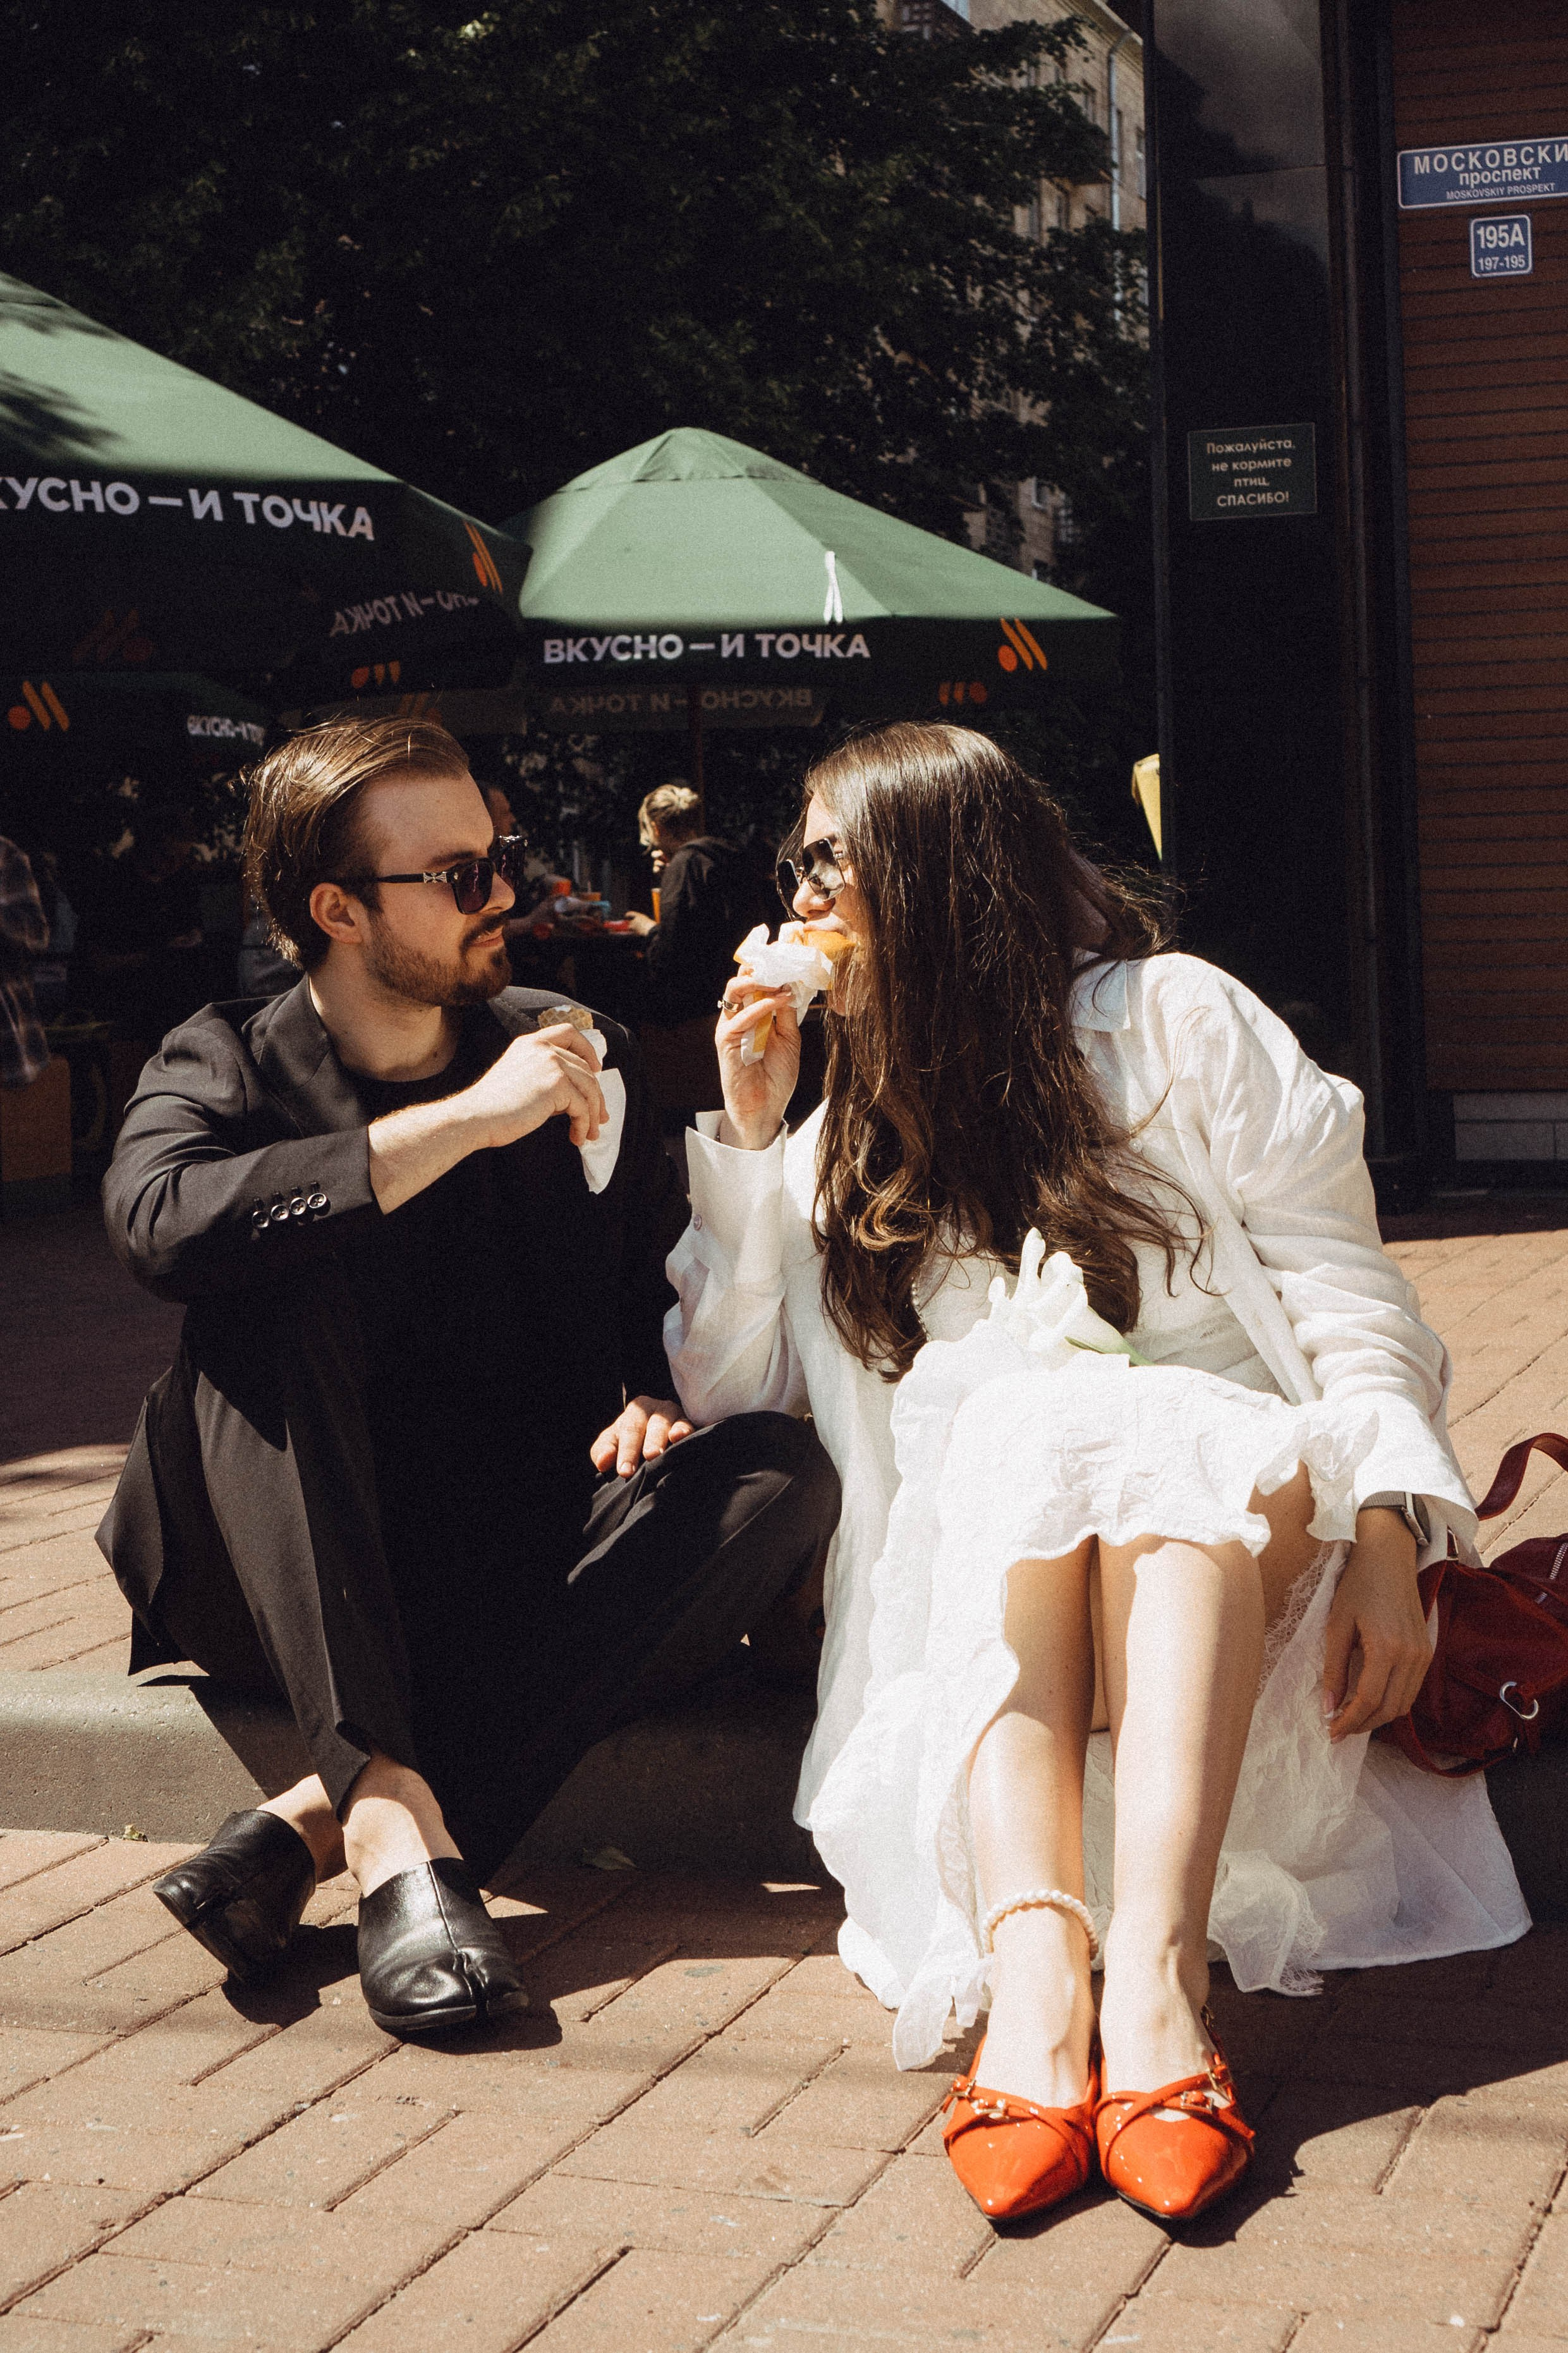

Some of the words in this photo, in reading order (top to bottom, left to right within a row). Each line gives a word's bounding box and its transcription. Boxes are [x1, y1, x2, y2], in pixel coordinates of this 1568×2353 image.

[1459, 167, 1541, 189] проспект
[1446, 186, 1505, 200] MOSKOVSKIY
[1507, 182, 1556, 195] PROSPEKT
[1476, 223, 1526, 249] 195А
[1478, 255, 1526, 271] 197-195
[1212, 461, 1229, 472] не
[1232, 458, 1292, 472] кормите
[1217, 491, 1290, 506] СПАСИБО!
[0, 477, 140, 516] УСНО
[188, 488, 224, 522] И
[231, 491, 375, 541] ТОЧКА
[543, 633, 684, 664] ВКУСНО
[720, 634, 744, 658] И
[755, 633, 871, 659] ТОЧКА
